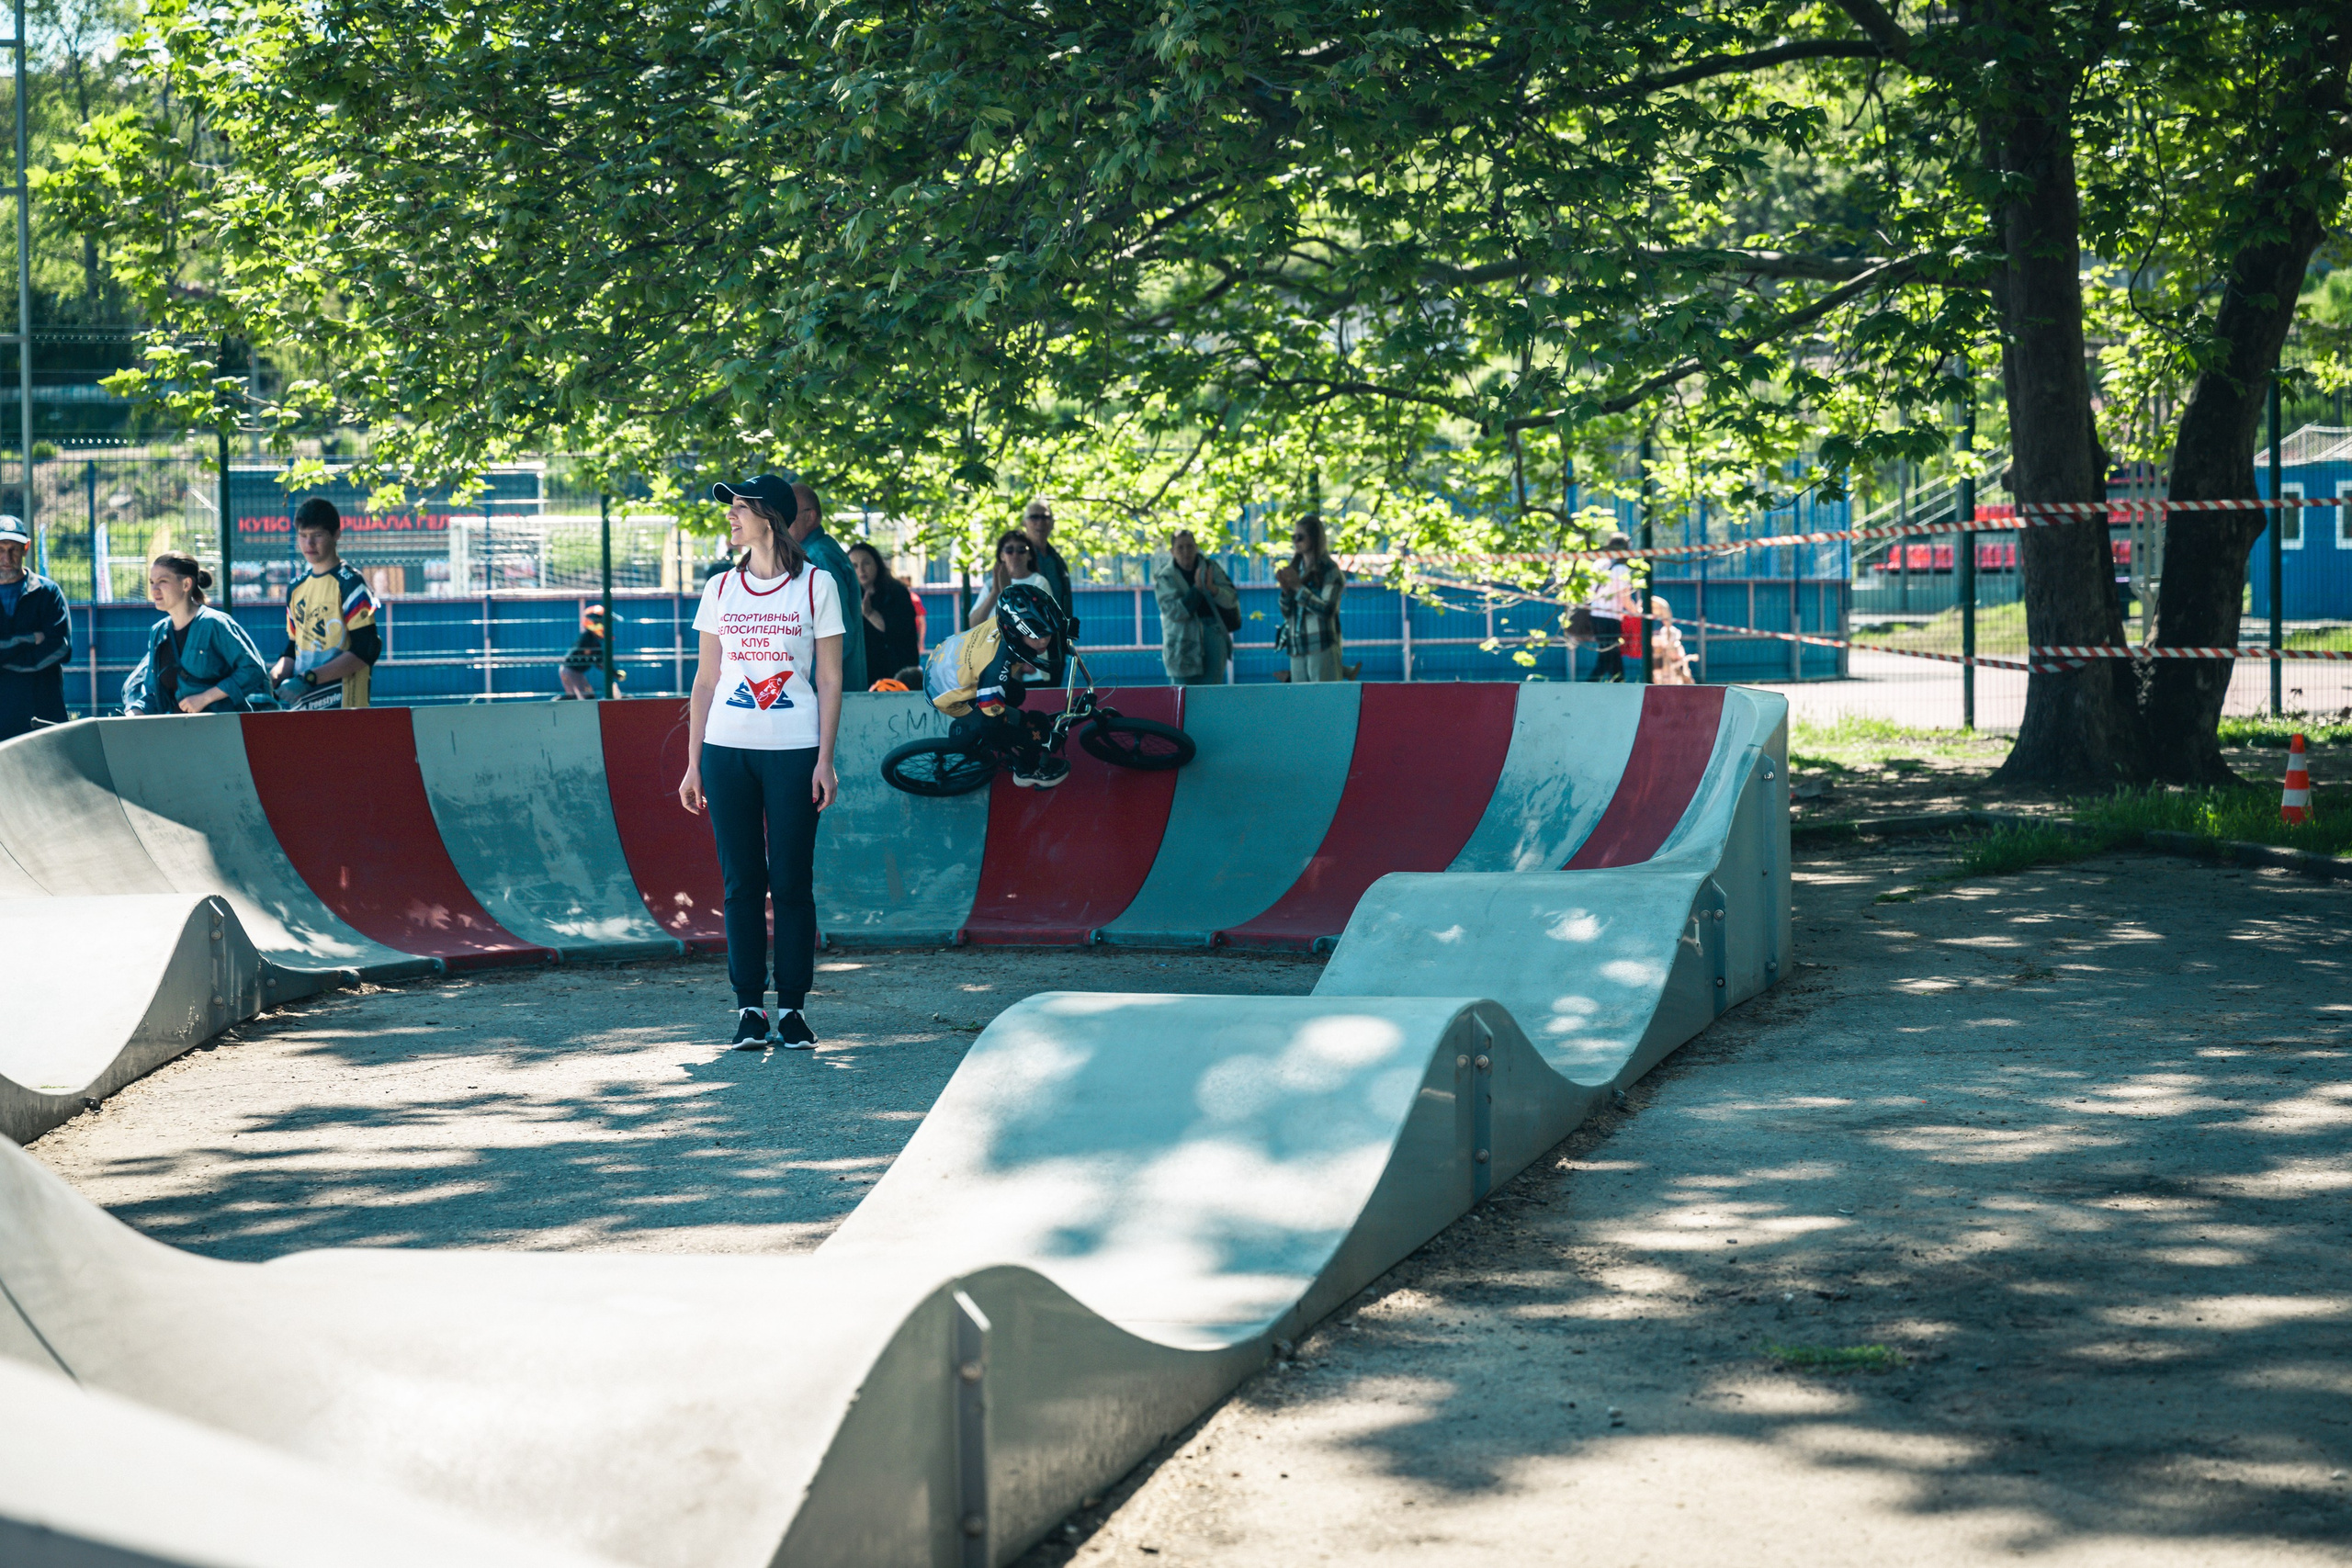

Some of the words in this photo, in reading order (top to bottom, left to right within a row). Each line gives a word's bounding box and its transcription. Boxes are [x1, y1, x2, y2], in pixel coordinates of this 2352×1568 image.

[238, 515, 291, 533] КУБО
[339, 514, 413, 531] РШАЛА
[741, 637, 770, 648] КЛУБ
